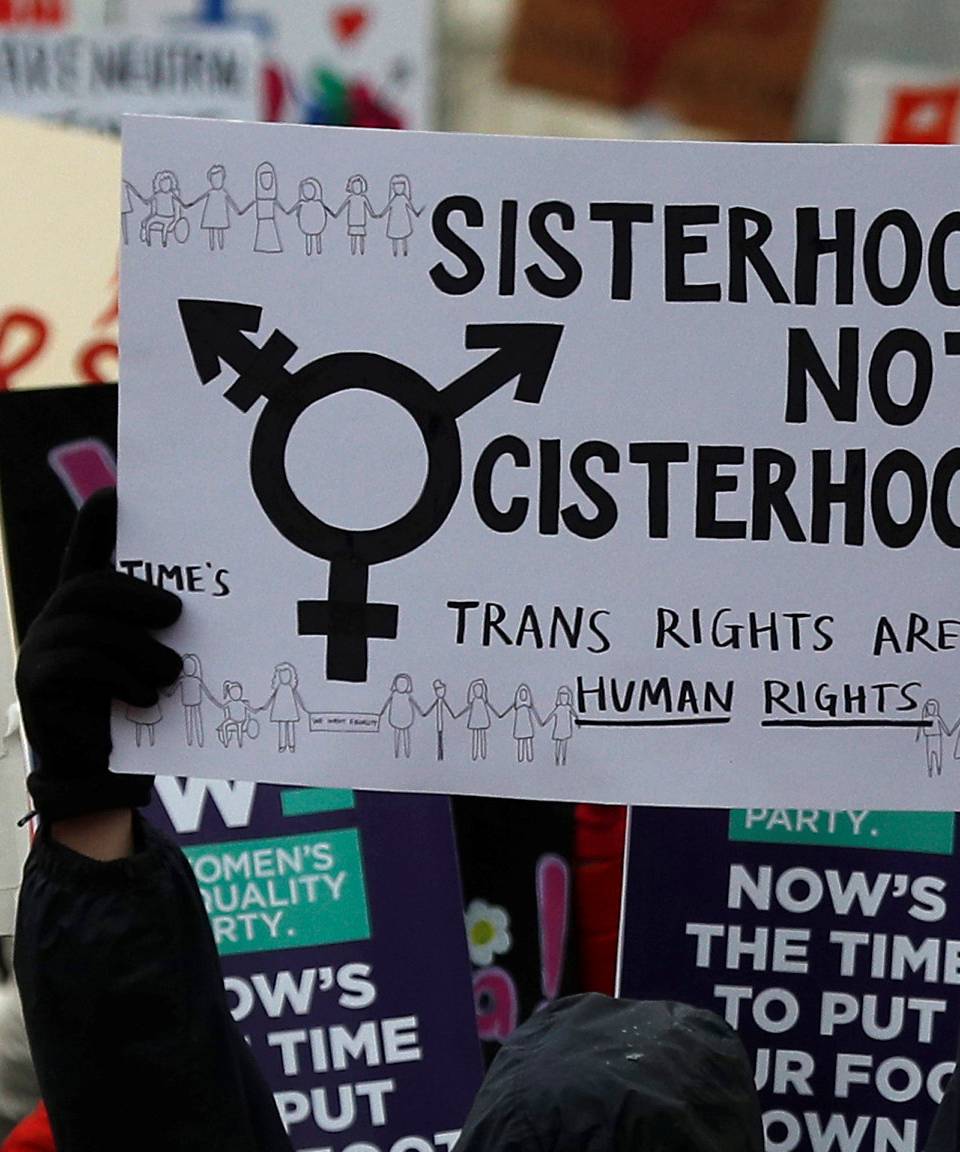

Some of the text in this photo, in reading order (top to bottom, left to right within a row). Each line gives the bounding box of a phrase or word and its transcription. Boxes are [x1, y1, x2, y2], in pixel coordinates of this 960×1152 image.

[119, 560, 230, 597] TIME'S
[447, 601, 611, 653] TRANS
[655, 607, 834, 652] RIGHTS
[576, 676, 922, 717] HUMAN RIGHTS
[745, 808, 879, 837] PARTY.
[193, 843, 335, 884] OMEN'S
[203, 869, 347, 914] UALITY
[727, 863, 947, 922] NOW'S
[212, 910, 296, 944] RTY.
[685, 922, 812, 974] THE
[223, 962, 378, 1022] OW'S
[713, 984, 948, 1044] TO PUT
[267, 1015, 423, 1077] TIME
[272, 1078, 395, 1134] PUT
